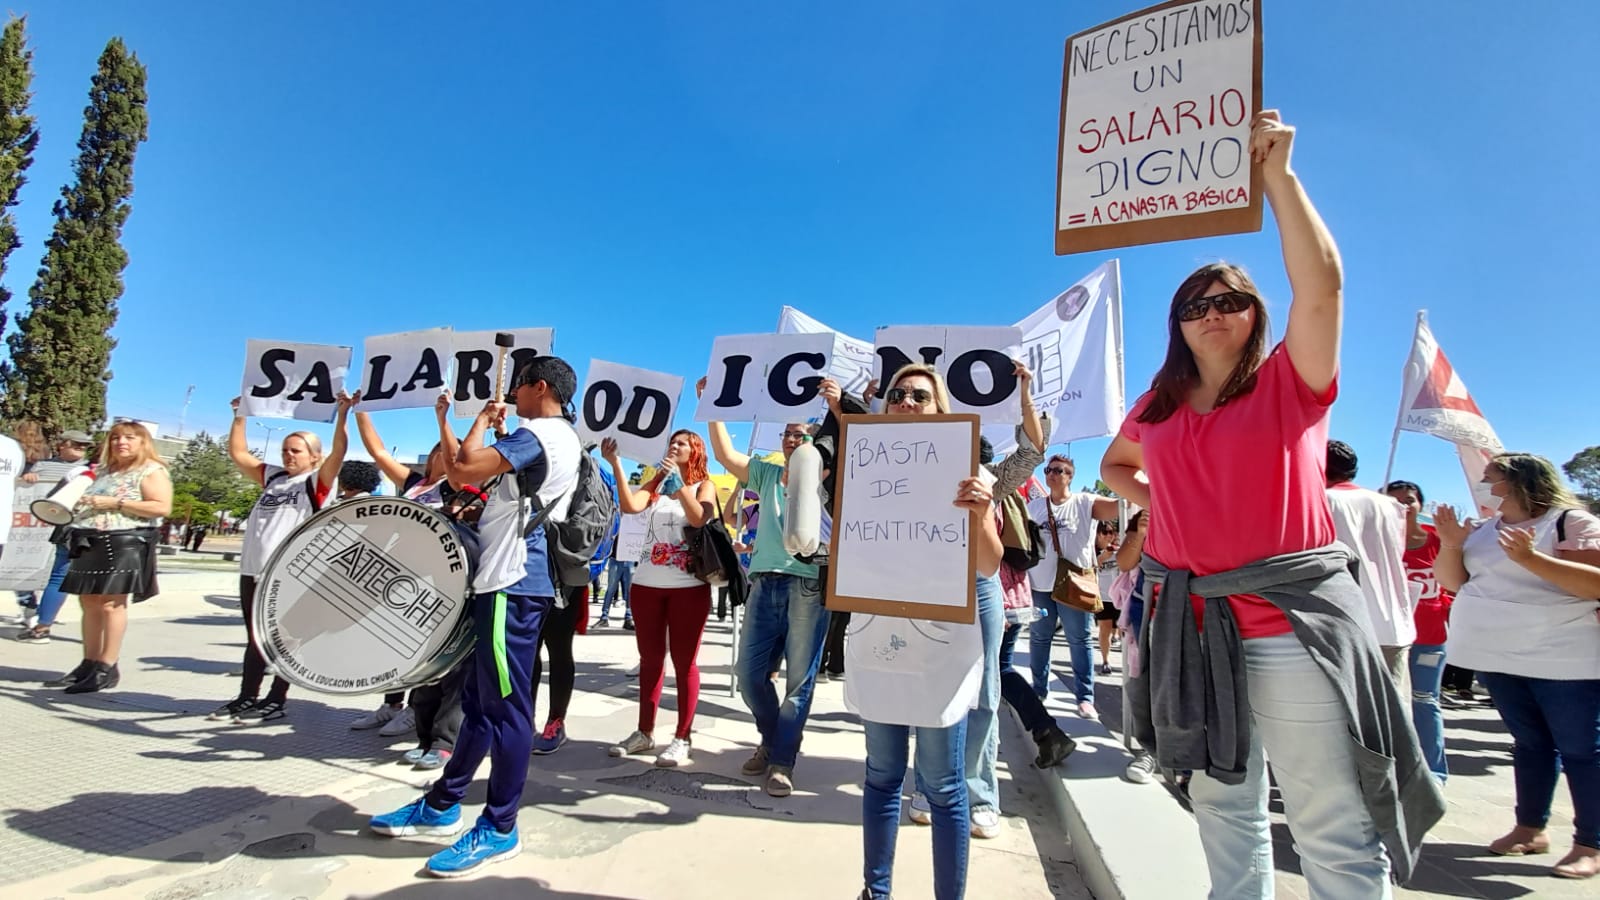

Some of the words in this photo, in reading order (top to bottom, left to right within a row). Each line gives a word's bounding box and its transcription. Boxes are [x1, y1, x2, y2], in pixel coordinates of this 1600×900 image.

[1072, 0, 1250, 77] NECESITAMOS
[1133, 58, 1182, 93] UN
[1078, 88, 1246, 154] SALARIO
[1085, 137, 1242, 198] DIGNO
[1091, 205, 1102, 224] A
[1107, 193, 1179, 223] CANASTA
[1182, 186, 1248, 211] BÁSICA
[850, 437, 939, 480] ¡BASTA
[870, 478, 911, 499] DE
[355, 503, 440, 533] REGIONAL
[438, 531, 463, 573] ESTE
[844, 518, 967, 548] MENTIRAS!
[267, 618, 278, 629] DE
[297, 666, 309, 678] DE
[306, 670, 316, 681] LA
[356, 677, 369, 688] DEL
[370, 667, 399, 685] CHUBUT
